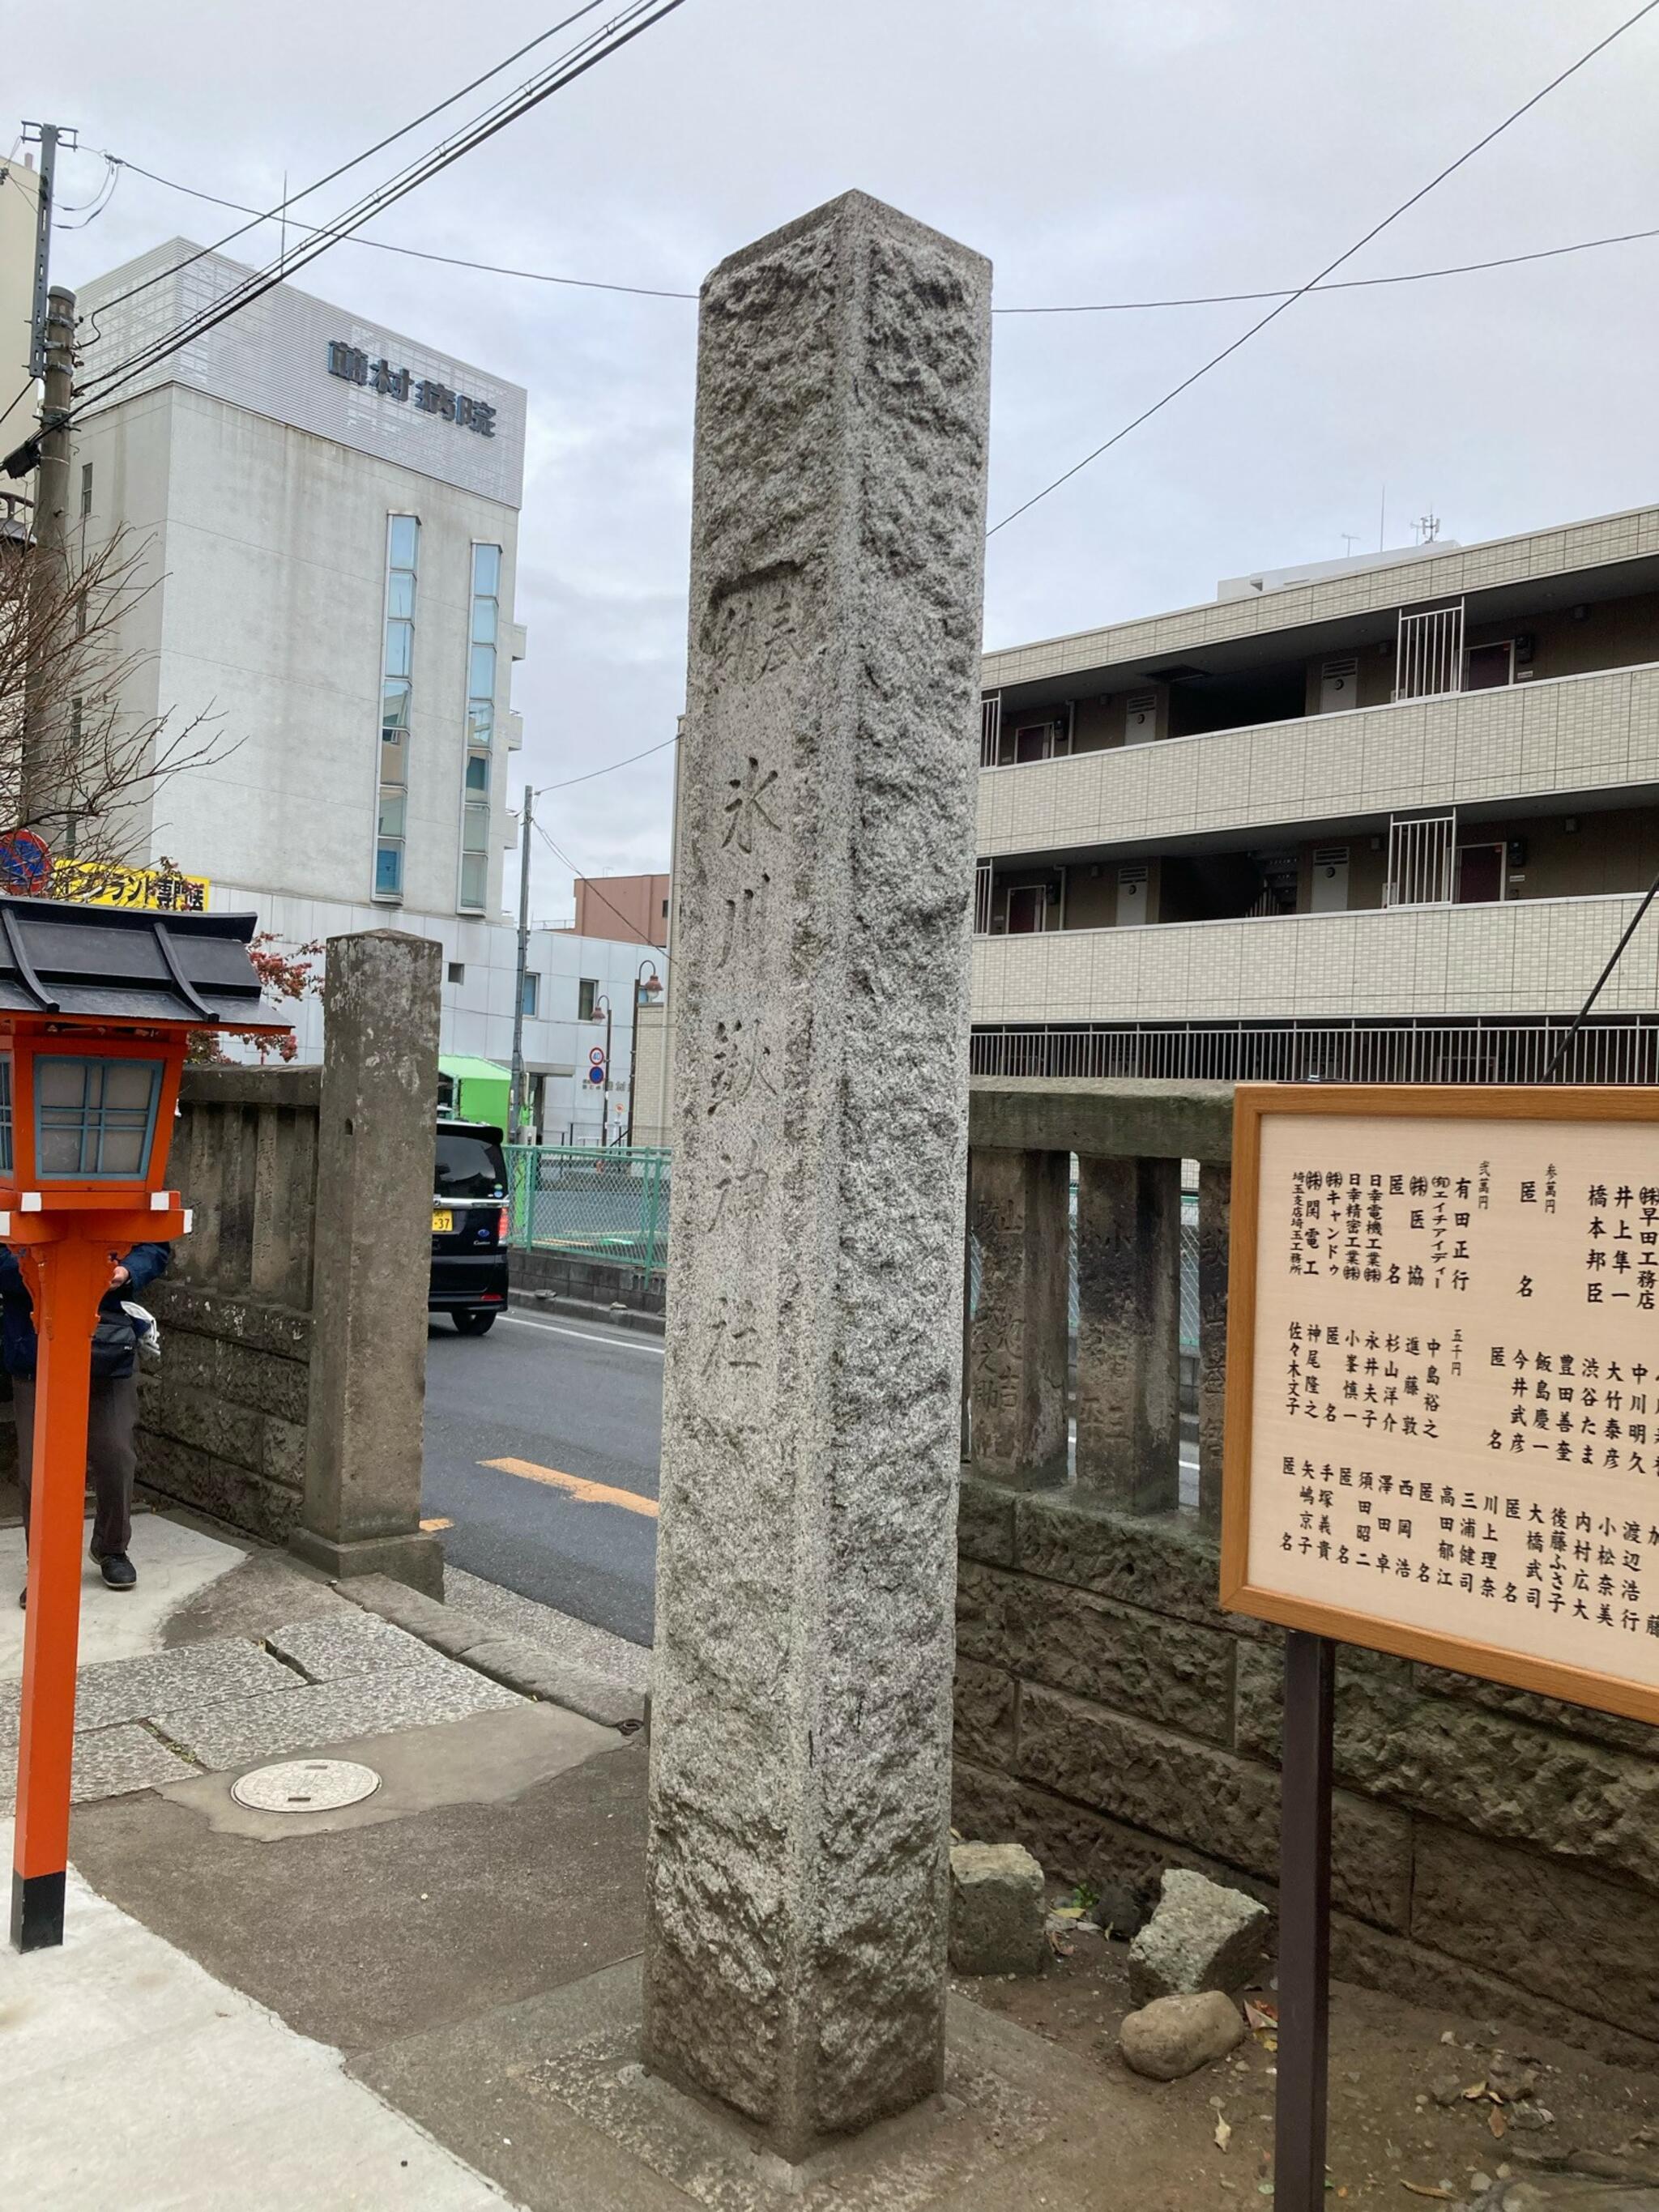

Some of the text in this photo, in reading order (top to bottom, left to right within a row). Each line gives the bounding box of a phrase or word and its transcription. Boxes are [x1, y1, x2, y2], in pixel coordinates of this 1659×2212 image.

[1452, 1178, 1472, 1291] 有田正行
[1586, 1185, 1608, 1302] 橋本邦臣
[1611, 1186, 1633, 1298] 井上隼一
[1286, 1322, 1303, 1414] 佐々木文子
[1304, 1324, 1321, 1418] 神尾隆之
[1383, 1334, 1400, 1432] 杉山洋介
[1402, 1337, 1420, 1435] 進藤敦
[1423, 1339, 1441, 1438] 中島裕之
[1451, 1329, 1463, 1376] 五千円
[1510, 1349, 1529, 1453] 今井武彦
[1533, 1352, 1552, 1449] 飯島慶一
[1580, 1358, 1599, 1464] 渋谷たま
[1603, 1362, 1623, 1468] 大竹泰彦
[1628, 1363, 1648, 1474] 中川明久
[1299, 1460, 1316, 1554] 矢嶋京子
[1317, 1464, 1333, 1560] 手塚義貴
[1356, 1472, 1373, 1566] 須田昭二
[1375, 1475, 1393, 1573] 澤田卓
[1396, 1480, 1414, 1578] 西岡浩
[1437, 1485, 1455, 1586] 高田郁江
[1460, 1493, 1477, 1592] 三浦健司
[1480, 1496, 1498, 1597] 川上理奈
[1526, 1503, 1545, 1609] 大橋武司
[1548, 1507, 1567, 1613] 後藤ふさ子
[1572, 1511, 1591, 1620] 内村広大
[1597, 1517, 1616, 1626] 小松奈美
[1621, 1520, 1641, 1632] 渡辺浩行
